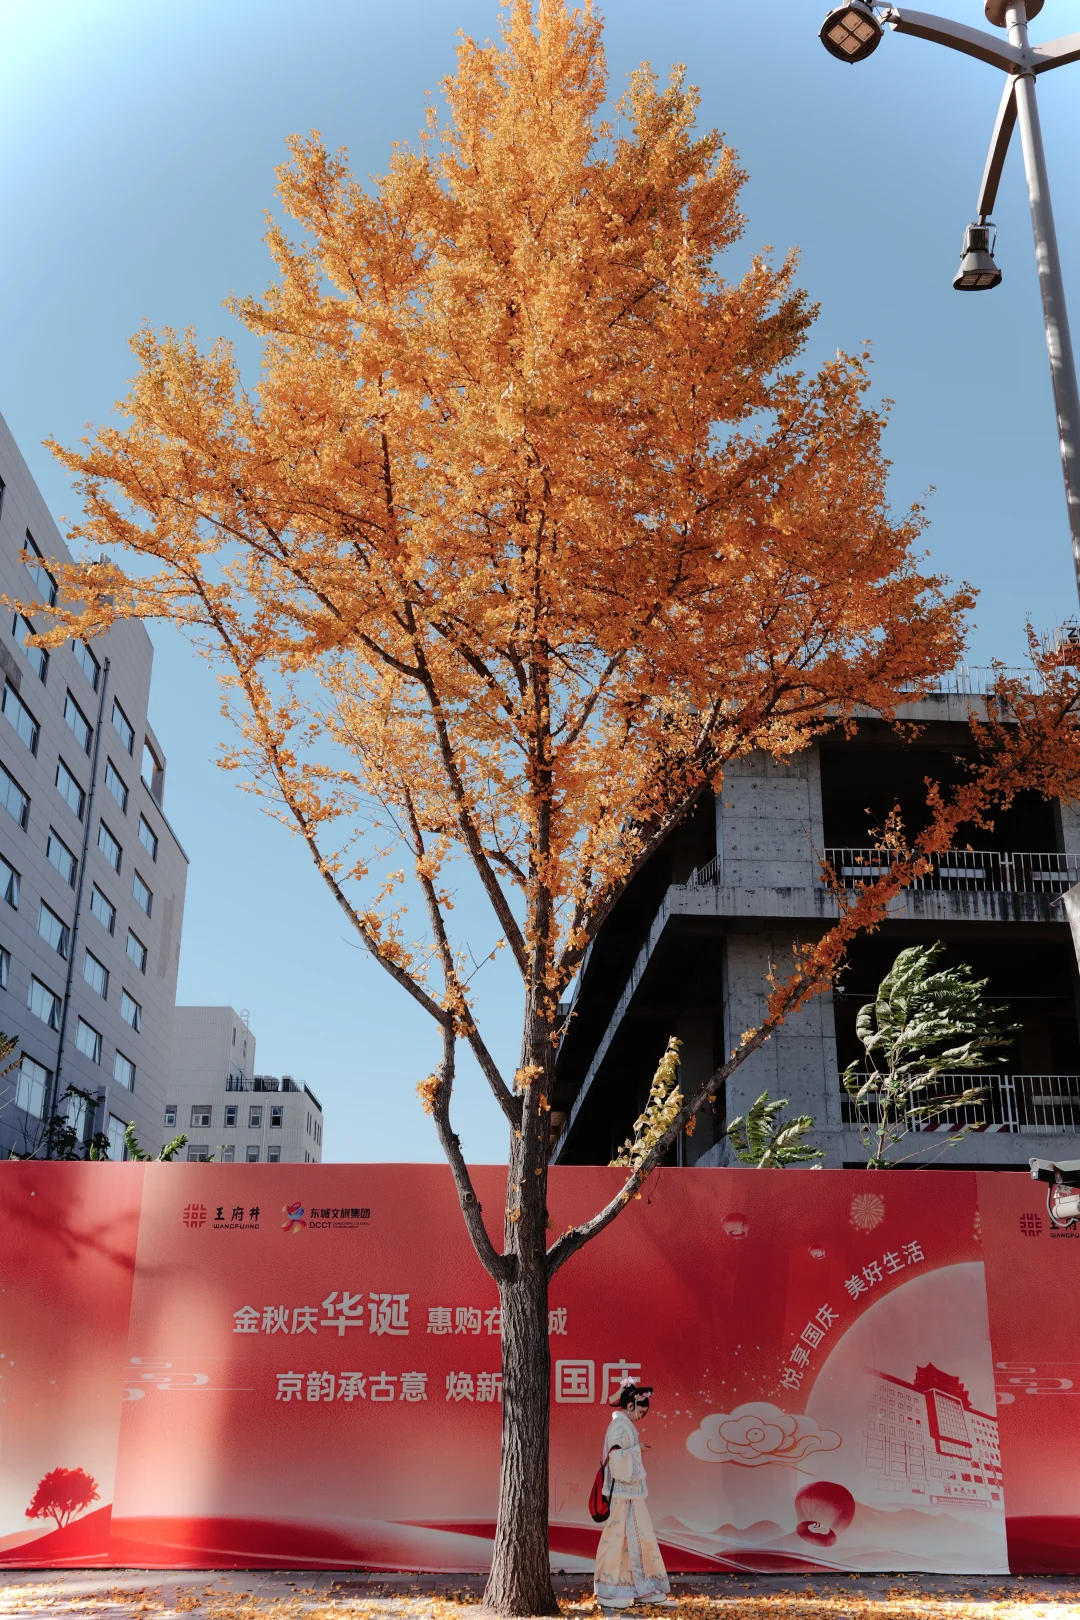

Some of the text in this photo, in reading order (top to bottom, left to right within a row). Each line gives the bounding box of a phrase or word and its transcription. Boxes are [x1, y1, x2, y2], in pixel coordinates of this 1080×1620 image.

[214, 1206, 260, 1222] 王府井
[309, 1221, 332, 1229] DCCT
[310, 1208, 371, 1219] 东城文旅集团
[232, 1291, 568, 1337] 金秋庆华诞 惠购在城
[779, 1240, 925, 1391] 悦享国庆 美好生活
[275, 1370, 428, 1403] 京韵承古意
